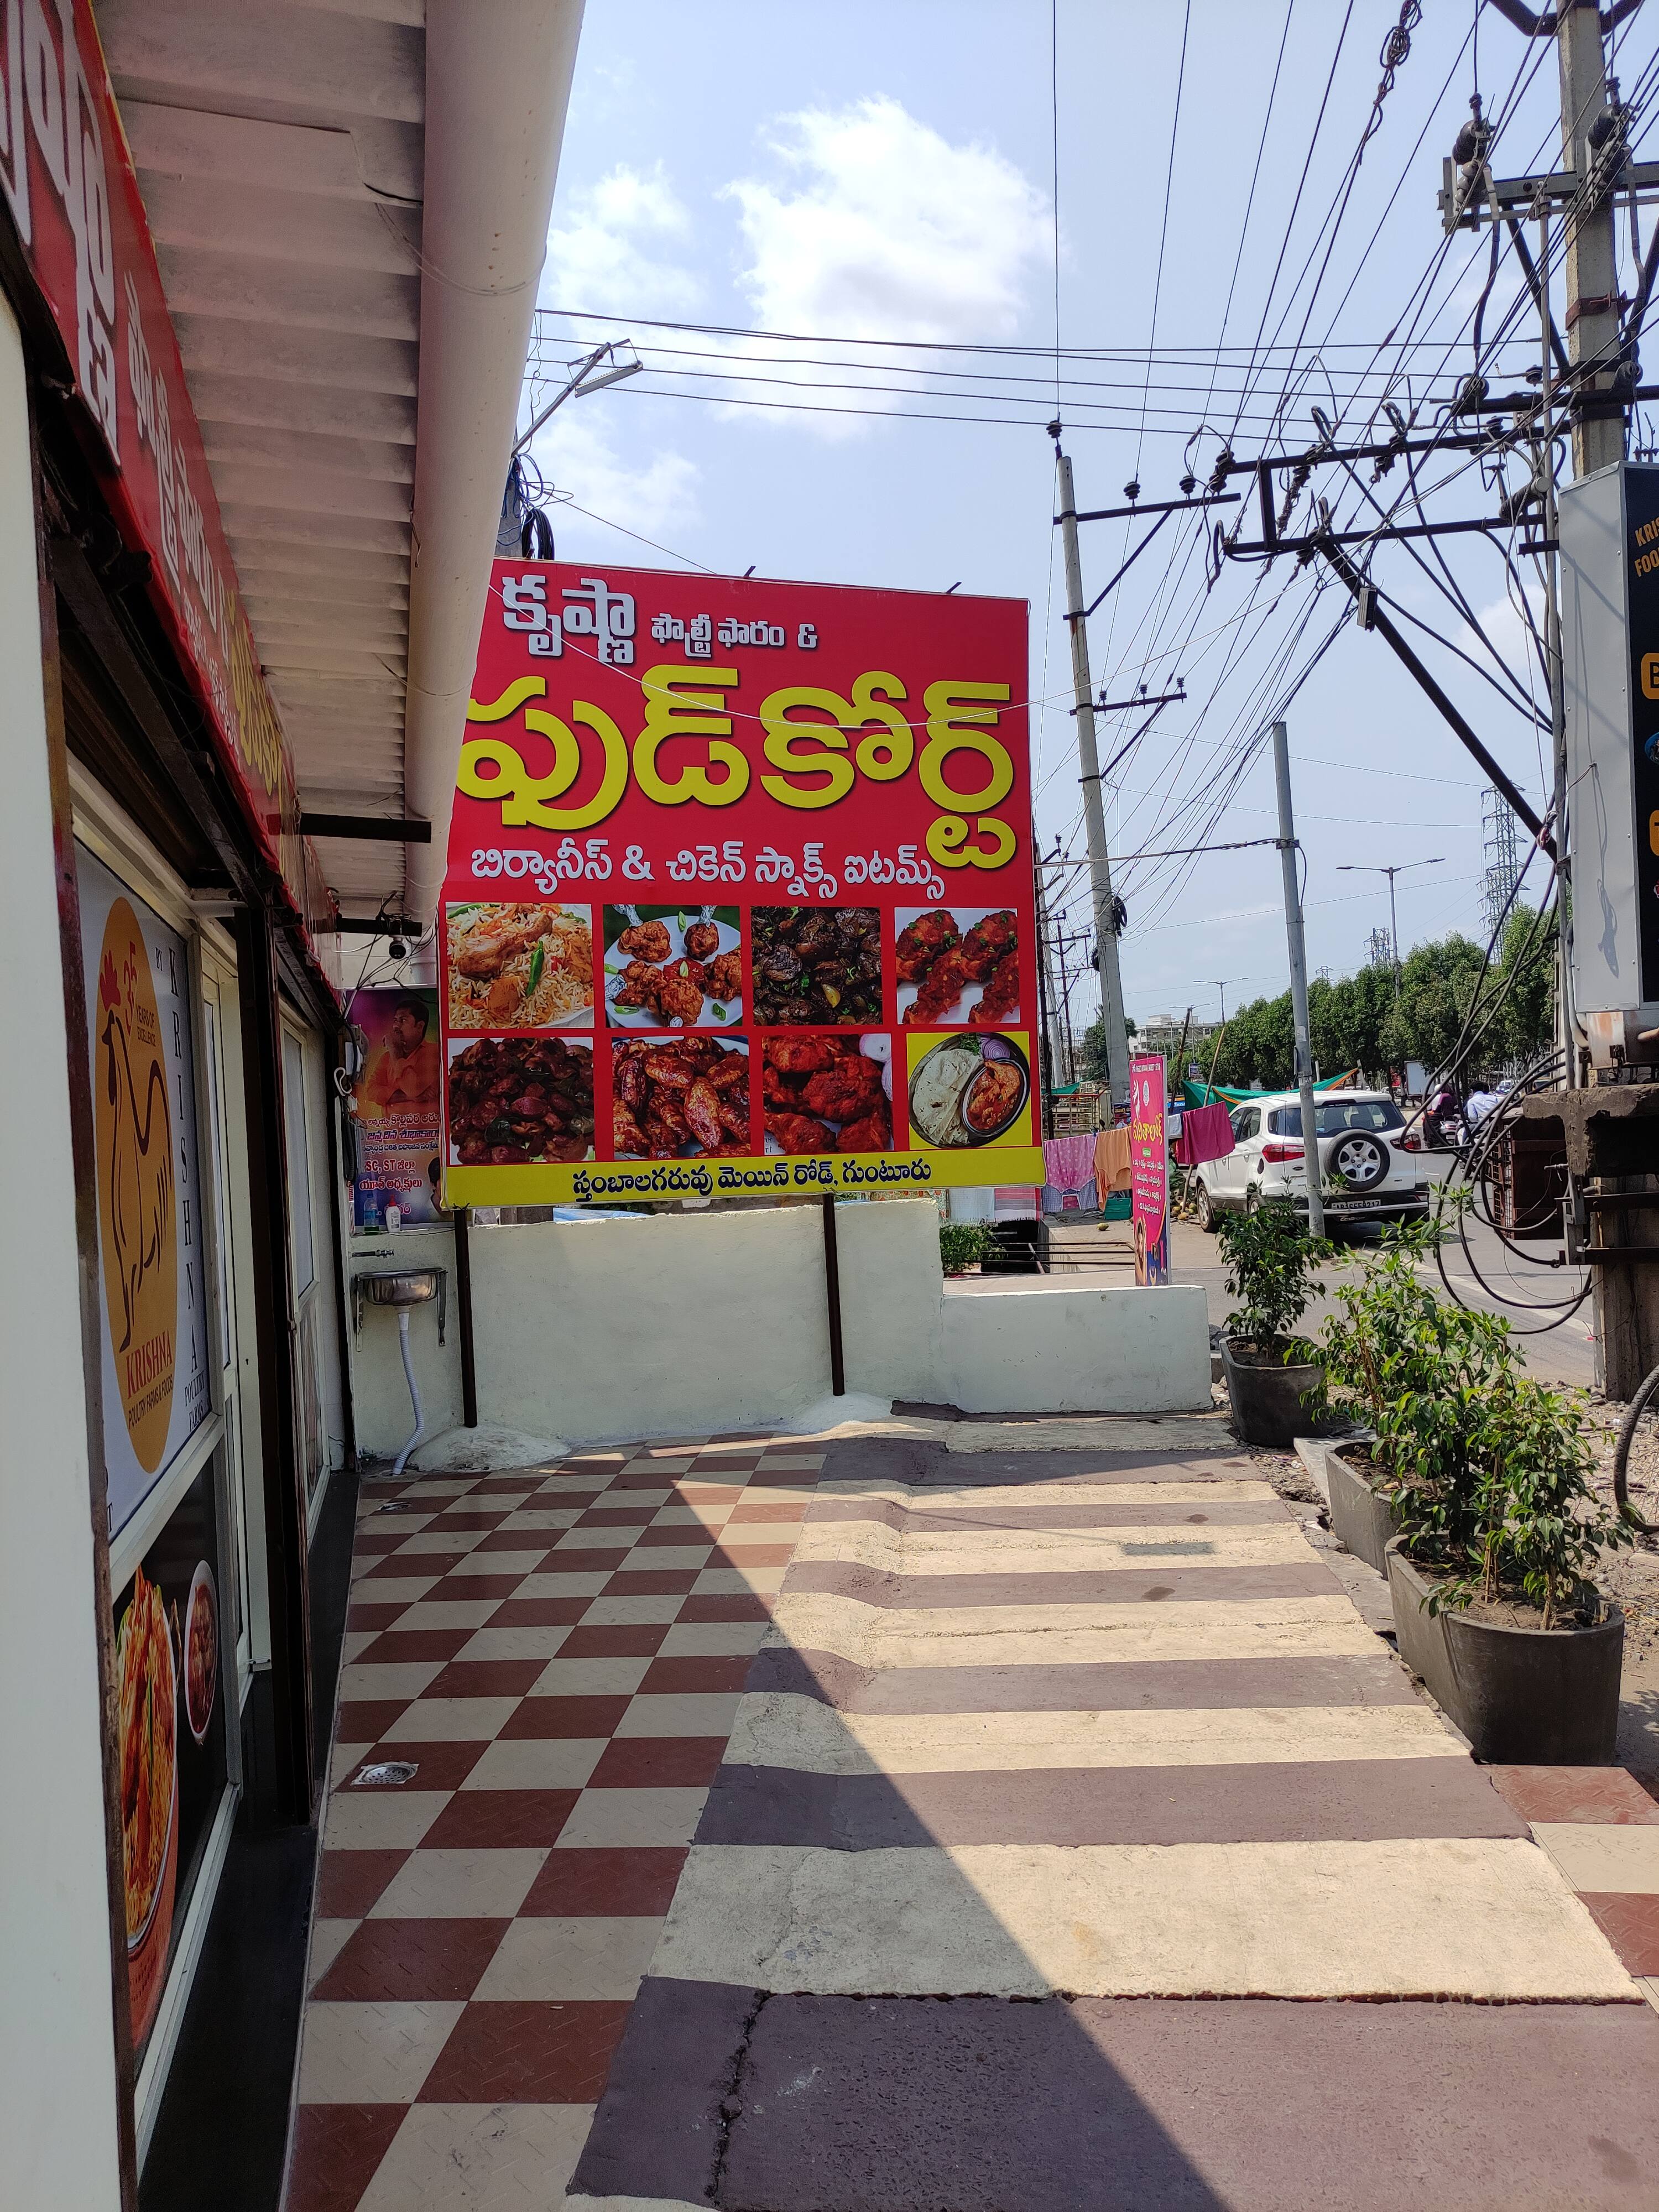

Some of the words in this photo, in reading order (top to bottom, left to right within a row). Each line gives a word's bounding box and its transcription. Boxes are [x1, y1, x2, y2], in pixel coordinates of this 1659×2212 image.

[1634, 547, 1659, 577] FOO
[502, 575, 635, 664] కృష్ణా
[718, 617, 785, 648] ఫారం
[798, 623, 817, 648] &
[455, 664, 750, 830] ఫుడ్
[759, 670, 1016, 869] కోర్ట్
[471, 837, 613, 895] బిర్యానీస్
[622, 844, 655, 880] &
[665, 841, 747, 882] చికెన్
[755, 842, 838, 899] స్నాక్స్
[844, 844, 946, 900] ఐటమ్స్
[155, 947, 163, 972] BY
[136, 1004, 149, 1027] YEARS
[149, 1011, 154, 1029] OF
[137, 1026, 156, 1047] EXCELLENCE
[359, 1176, 387, 1191] యూత్
[366, 1160, 382, 1173] SC,
[384, 1160, 395, 1171] ST
[573, 1164, 713, 1202] స్తంబాలగరువు
[717, 1162, 789, 1188] మెయిన్
[794, 1159, 838, 1187] రోడ్,
[842, 1157, 931, 1183] గుంటూరు
[126, 1329, 173, 1400] KRISHNA
[128, 1396, 147, 1431] POULTRY
[146, 1386, 159, 1414] FARMS
[161, 1374, 173, 1400] FOODS
[184, 1370, 205, 1407] POULTRY
[189, 1400, 204, 1432] FARMS
